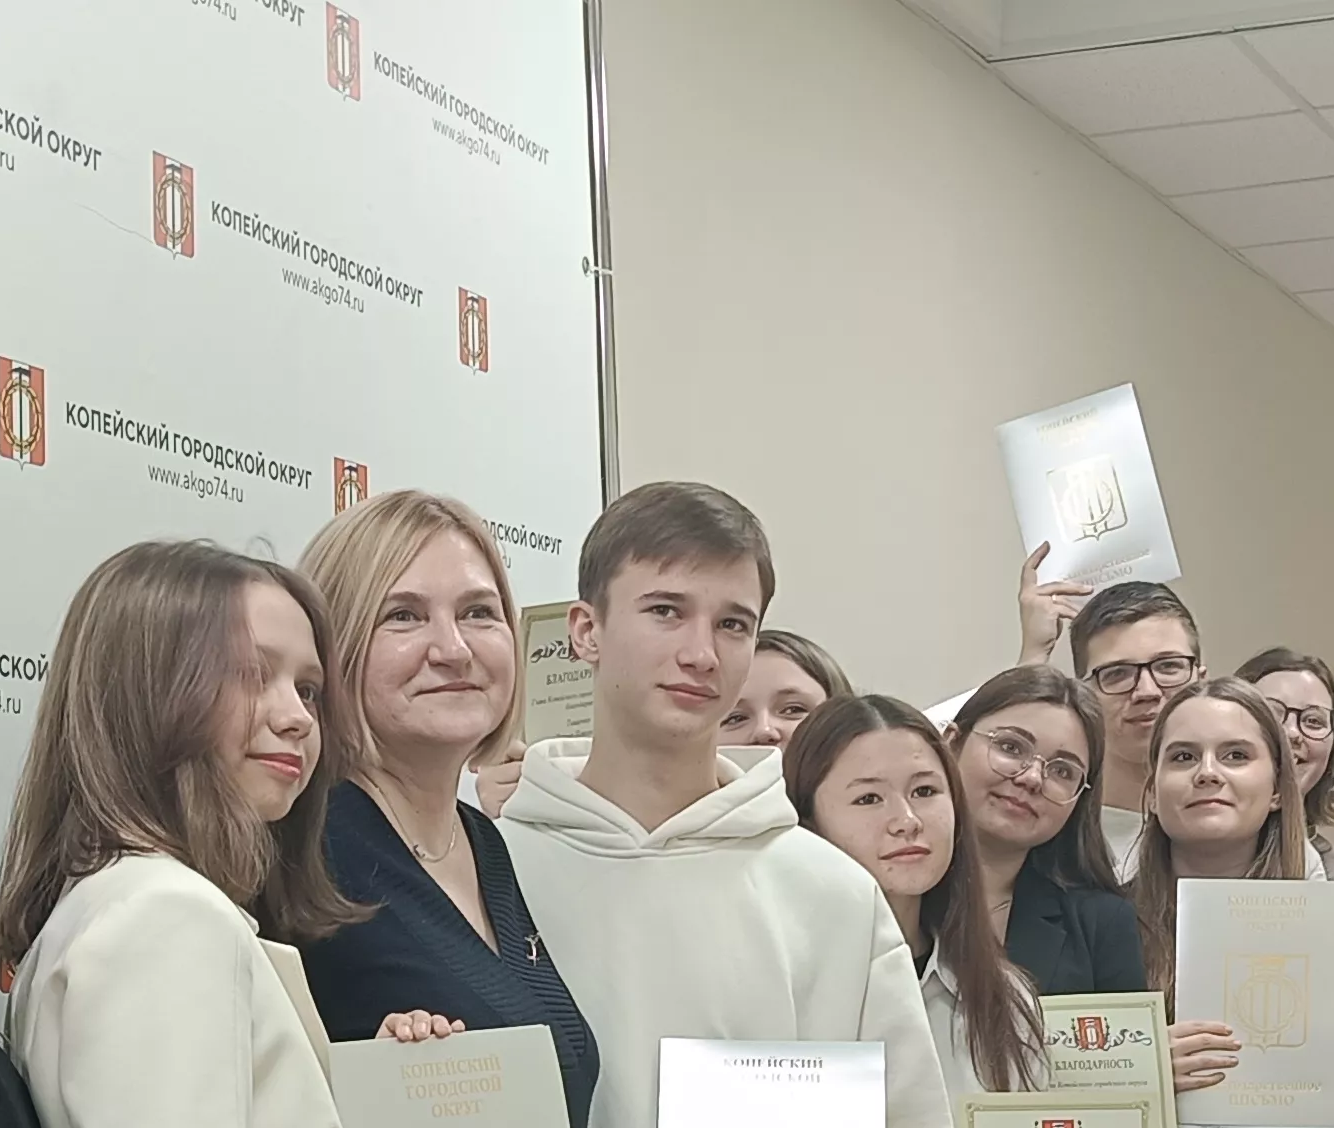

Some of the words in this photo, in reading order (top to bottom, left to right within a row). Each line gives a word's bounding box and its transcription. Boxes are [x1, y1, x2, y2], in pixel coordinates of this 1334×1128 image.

[373, 50, 448, 110] КОПЕЙСКИЙ
[449, 91, 516, 148] ГОРОДСКОЙ
[517, 133, 550, 165] ОКРУГ
[47, 130, 102, 171] ОКРУГ
[211, 200, 300, 257] КОПЕЙСКИЙ
[303, 240, 383, 292] ГОРОДСКОЙ
[385, 276, 423, 307] ОКРУГ
[282, 267, 365, 313] www.akgo74.ru
[66, 401, 169, 452] КОПЕЙСКИЙ
[173, 432, 265, 478] ГОРОДСКОЙ
[268, 460, 312, 490] ОКРУГ
[148, 464, 244, 502] www.akgo74.ru
[529, 530, 562, 555] ОКРУГ
[401, 1053, 502, 1080] КОПЕЙСКИЙ
[405, 1075, 503, 1100] ГОРОДСКОЙ
[431, 1098, 485, 1119] ОКРУГ
